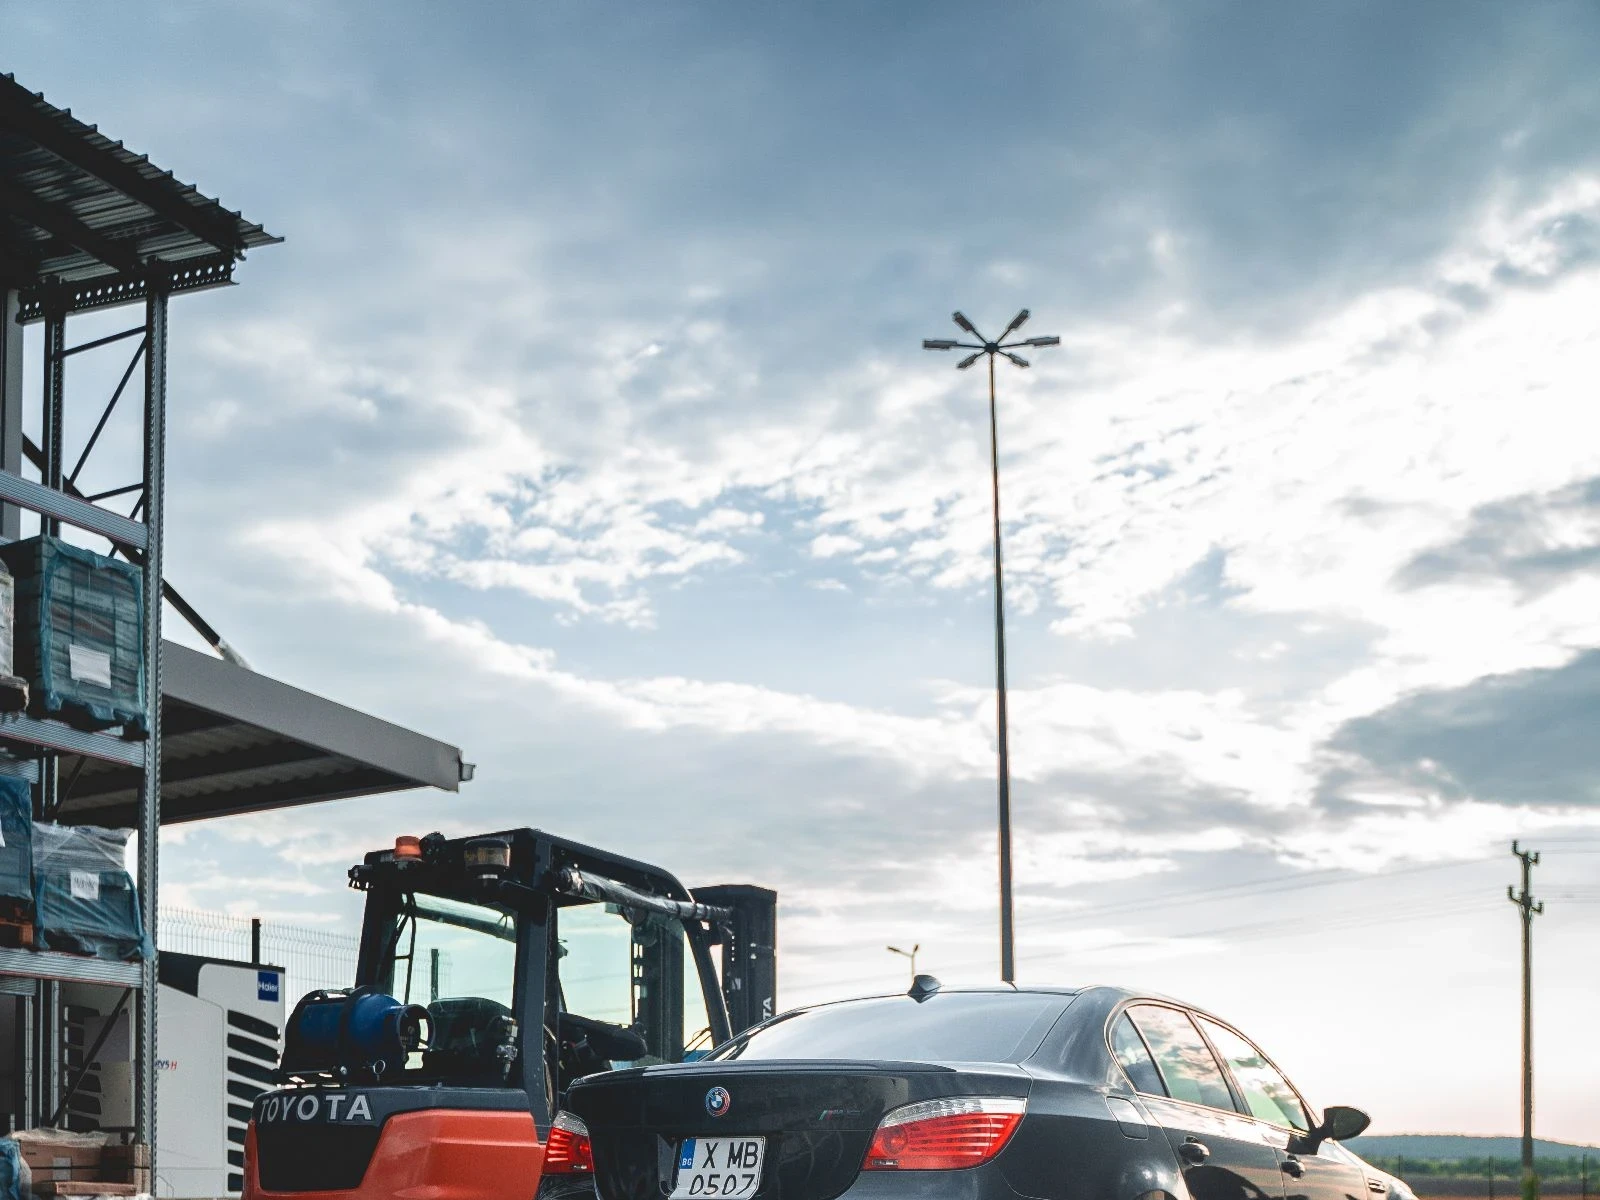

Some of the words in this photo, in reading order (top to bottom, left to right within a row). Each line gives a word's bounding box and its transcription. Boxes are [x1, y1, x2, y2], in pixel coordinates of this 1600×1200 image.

[257, 981, 279, 992] Haier
[259, 1095, 372, 1123] TOYOTA
[682, 1158, 692, 1166] BG
[702, 1142, 719, 1169] X
[726, 1141, 759, 1169] MB
[688, 1173, 756, 1196] 0507
